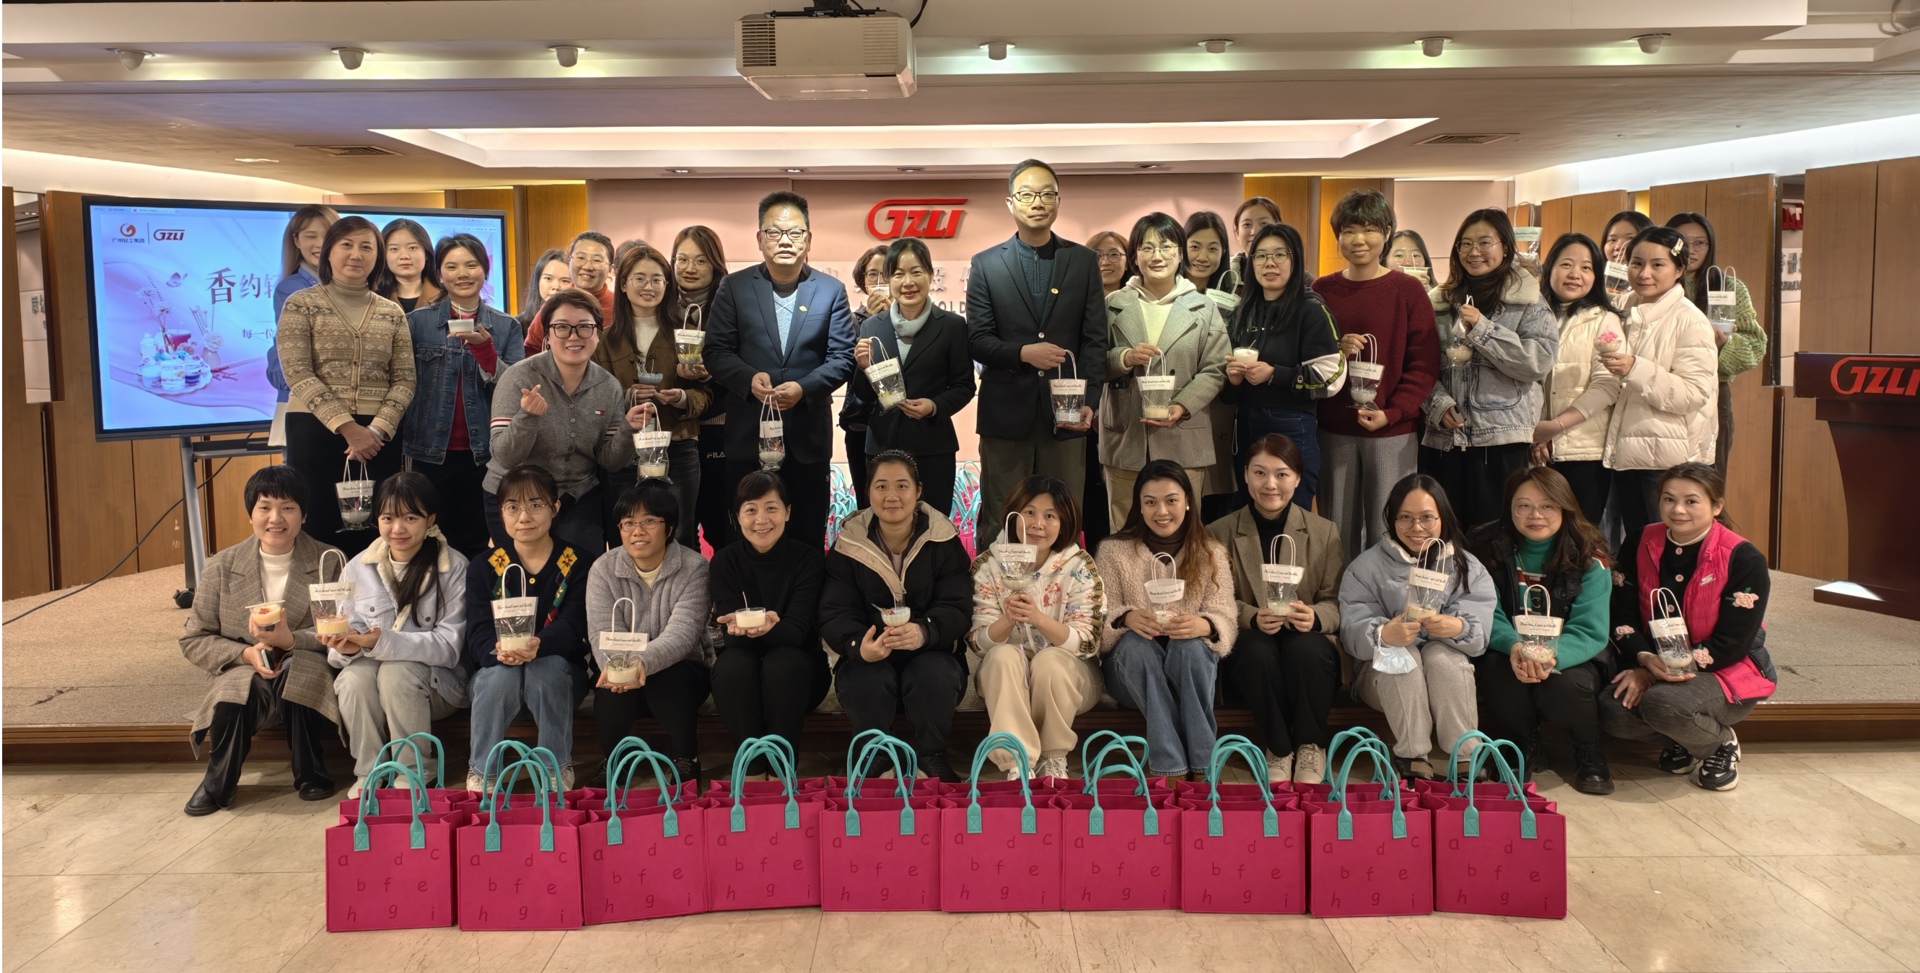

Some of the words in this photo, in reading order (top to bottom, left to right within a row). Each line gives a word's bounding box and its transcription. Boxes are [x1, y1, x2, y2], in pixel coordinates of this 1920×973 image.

[867, 198, 968, 240] GZLI
[153, 228, 186, 241] GZLI
[706, 451, 726, 459] FILA
[717, 834, 727, 846] a
[769, 833, 778, 845] d
[805, 826, 814, 838] c
[832, 836, 842, 848] a
[885, 838, 893, 852] d
[921, 833, 930, 846] c
[954, 832, 964, 845] a
[1007, 836, 1015, 848] d
[1043, 833, 1052, 845] c
[1074, 836, 1084, 849] a
[1128, 838, 1135, 851] d
[1163, 833, 1172, 845] c
[594, 849, 603, 861] a
[648, 843, 656, 856] d
[684, 834, 693, 846] c
[1194, 838, 1204, 850] a
[1248, 840, 1256, 853] d
[1284, 836, 1293, 848] c
[1323, 841, 1333, 854] a
[1377, 843, 1384, 855] d
[1411, 836, 1420, 848] c
[1449, 838, 1459, 851] a
[1504, 841, 1513, 854] d
[1543, 839, 1552, 850] c
[338, 855, 348, 866] a
[394, 853, 402, 866] d
[430, 848, 439, 860] c
[471, 854, 481, 866] a
[525, 854, 533, 867] d
[559, 851, 568, 863] c
[735, 859, 744, 871] b
[760, 857, 767, 871] f
[793, 859, 803, 870] e
[850, 860, 858, 873] b
[875, 862, 881, 876] f
[908, 866, 918, 877] e
[971, 858, 979, 871] b
[996, 860, 1003, 874] f
[1029, 865, 1039, 876] e
[1092, 861, 1100, 874] b
[1118, 862, 1124, 876] f
[1150, 866, 1160, 877] e
[1212, 863, 1221, 876] b
[1238, 864, 1245, 879] f
[1271, 868, 1281, 879] e
[1341, 866, 1349, 879] b
[1366, 866, 1373, 881] f
[1399, 869, 1408, 880] e
[1468, 864, 1477, 876] b
[1495, 865, 1501, 879] f
[1529, 871, 1540, 882] e
[613, 871, 621, 884] b
[638, 869, 646, 884] f
[673, 868, 683, 880] e
[357, 878, 366, 891] b
[384, 877, 391, 892] f
[417, 880, 428, 892] e
[488, 878, 497, 891] b
[514, 878, 522, 893] f
[547, 883, 557, 895] e
[727, 885, 735, 900] h
[960, 884, 969, 900] h
[841, 886, 850, 901] h
[1082, 887, 1091, 902] h
[1202, 889, 1212, 904] h
[1331, 893, 1340, 908] h
[1458, 889, 1467, 904] h
[347, 906, 356, 922] h
[478, 906, 488, 922] h
[605, 899, 613, 913] h
